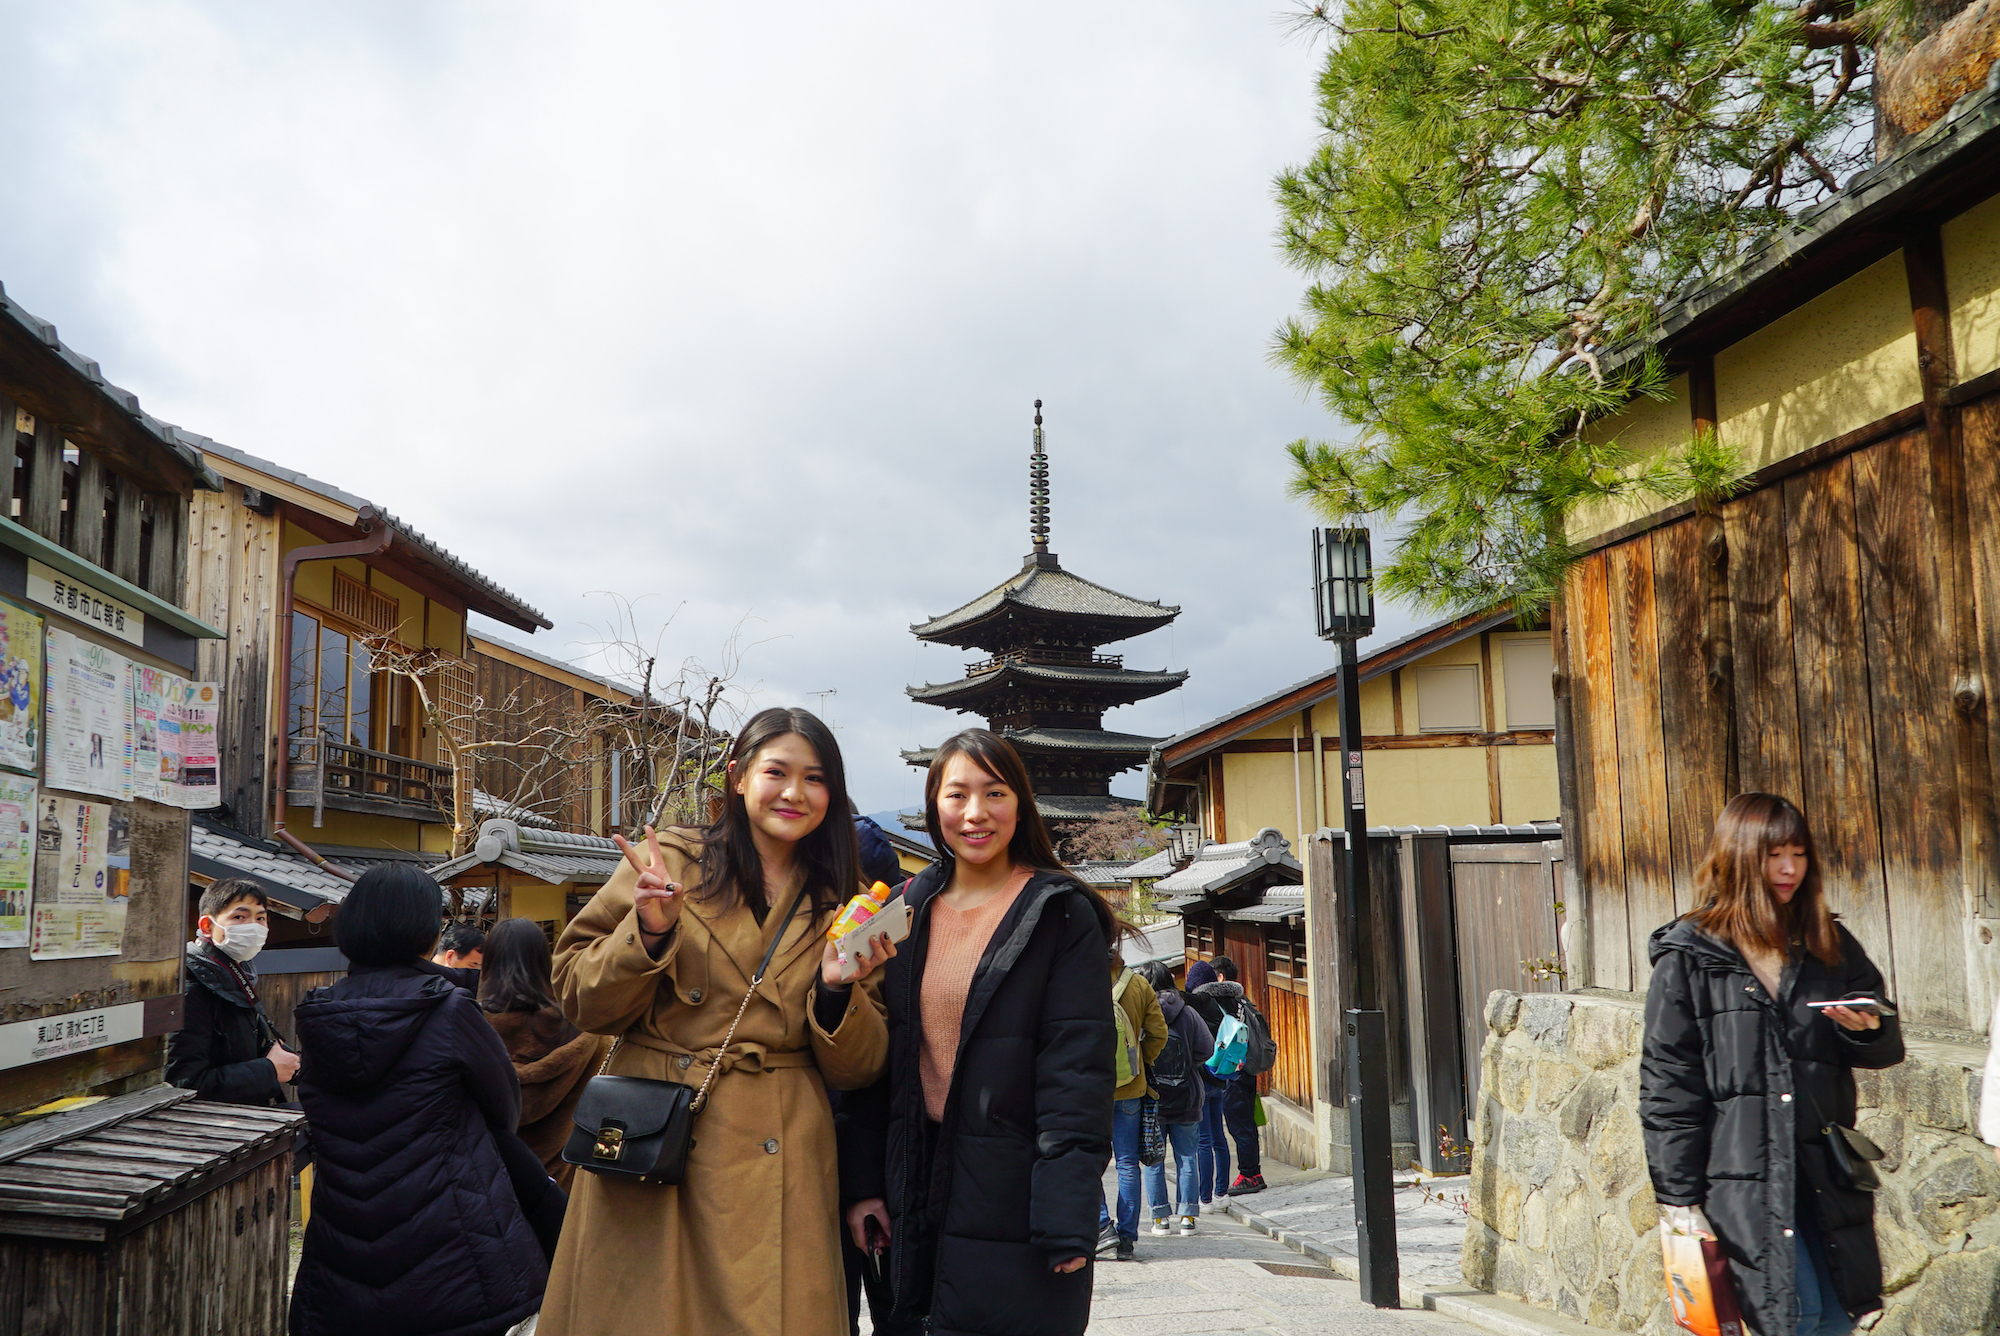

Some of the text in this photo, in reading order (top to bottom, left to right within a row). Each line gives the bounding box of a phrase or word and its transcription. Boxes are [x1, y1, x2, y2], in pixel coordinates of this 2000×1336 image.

[54, 579, 125, 633] 京都市広報板
[72, 804, 85, 888] 教育フォーラム
[228, 962, 255, 999] EOS DIGITAL
[38, 1015, 104, 1044] 東山区 清水三丁目
